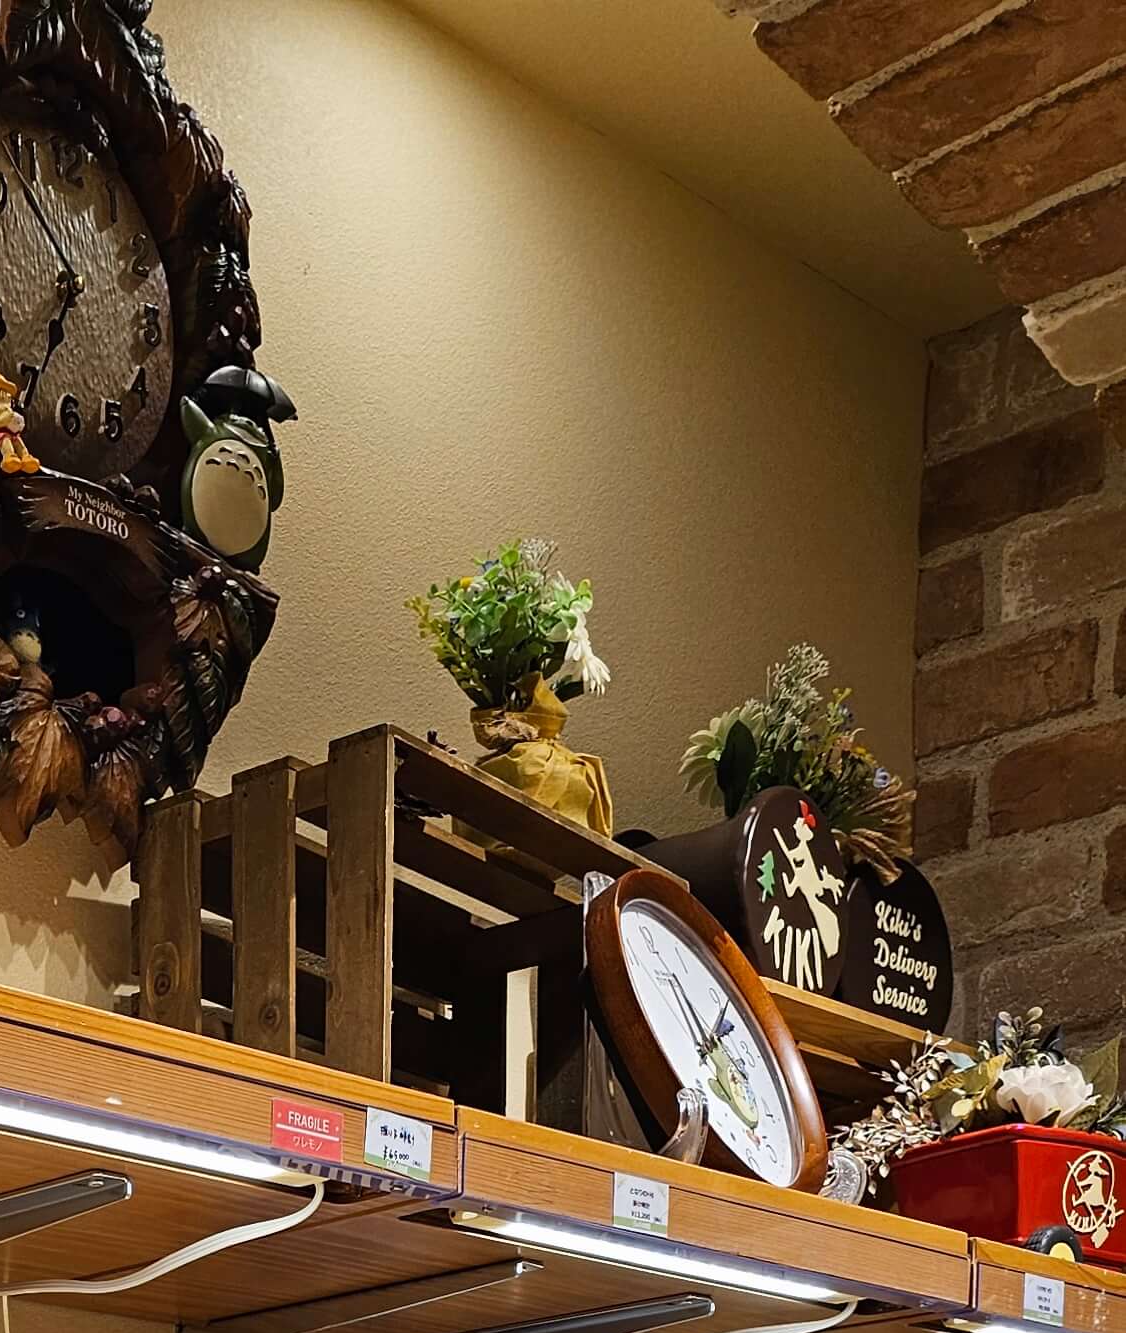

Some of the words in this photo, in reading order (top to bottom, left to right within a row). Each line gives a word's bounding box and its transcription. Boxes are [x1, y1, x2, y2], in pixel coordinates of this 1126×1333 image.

[131, 232, 151, 278] 2
[140, 303, 162, 347] 3
[21, 361, 40, 408] 7
[130, 366, 149, 409] 4
[58, 393, 81, 438] 6
[99, 400, 123, 442] 5
[64, 498, 128, 539] TOTORO
[68, 485, 82, 502] My
[85, 492, 126, 519] Neighbor
[874, 900, 922, 942] Kiki's
[874, 937, 938, 990] Delivery
[872, 974, 928, 1015] Service
[288, 1111, 330, 1134] FRAGILE
[292, 1136, 322, 1152] ワレモノ
